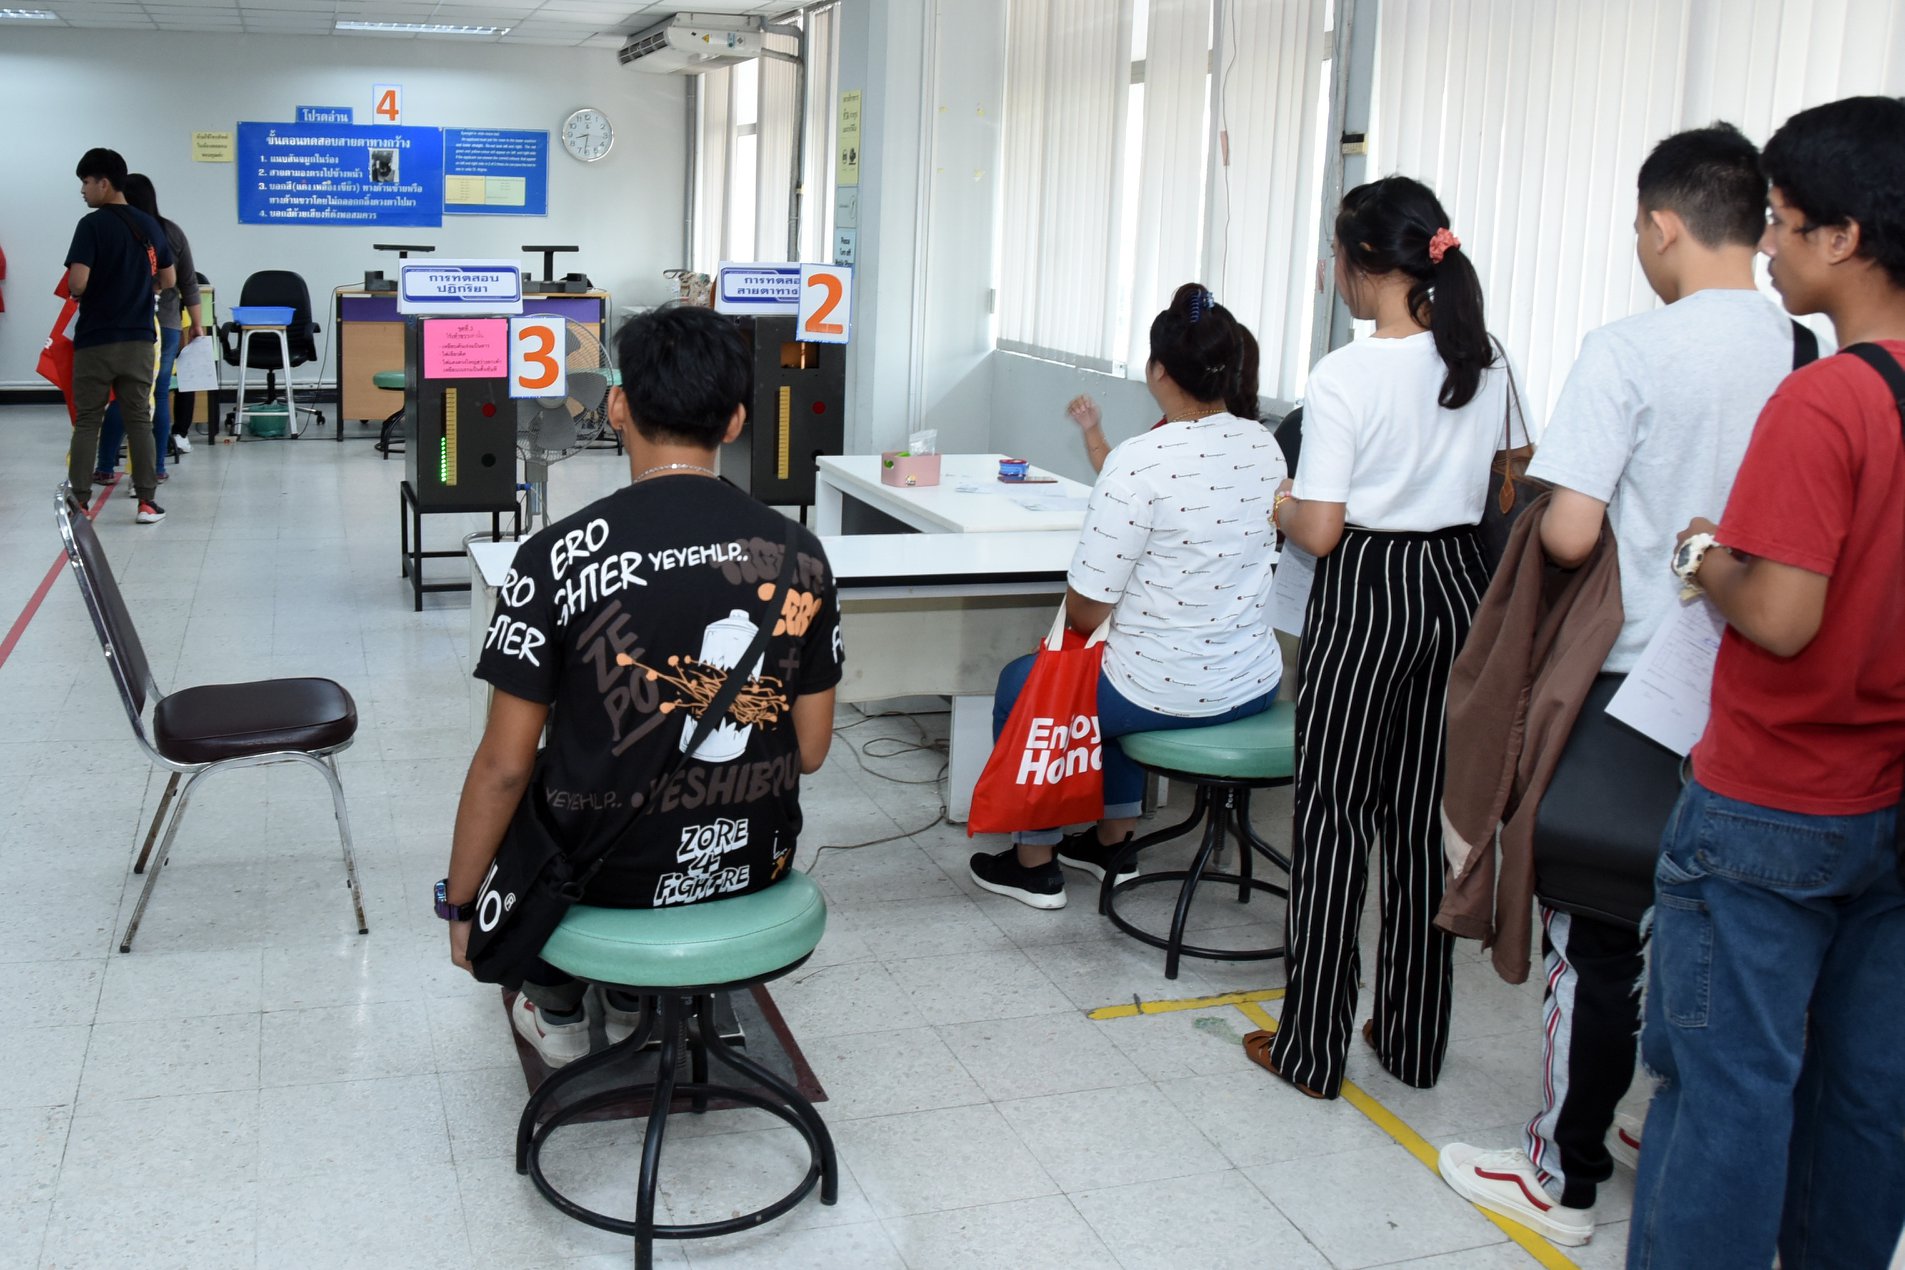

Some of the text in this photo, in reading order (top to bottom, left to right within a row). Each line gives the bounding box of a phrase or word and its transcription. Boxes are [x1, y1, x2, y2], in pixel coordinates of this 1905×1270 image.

[302, 108, 348, 123] โปรดอ่าน
[376, 89, 399, 121] 4
[258, 168, 268, 177] 2.
[258, 182, 268, 190] 3.
[429, 274, 499, 283] การทดสอบ
[804, 273, 844, 335] 2
[518, 324, 559, 389] 3
[1025, 713, 1102, 753] Enoy
[676, 818, 749, 864] ZORE
